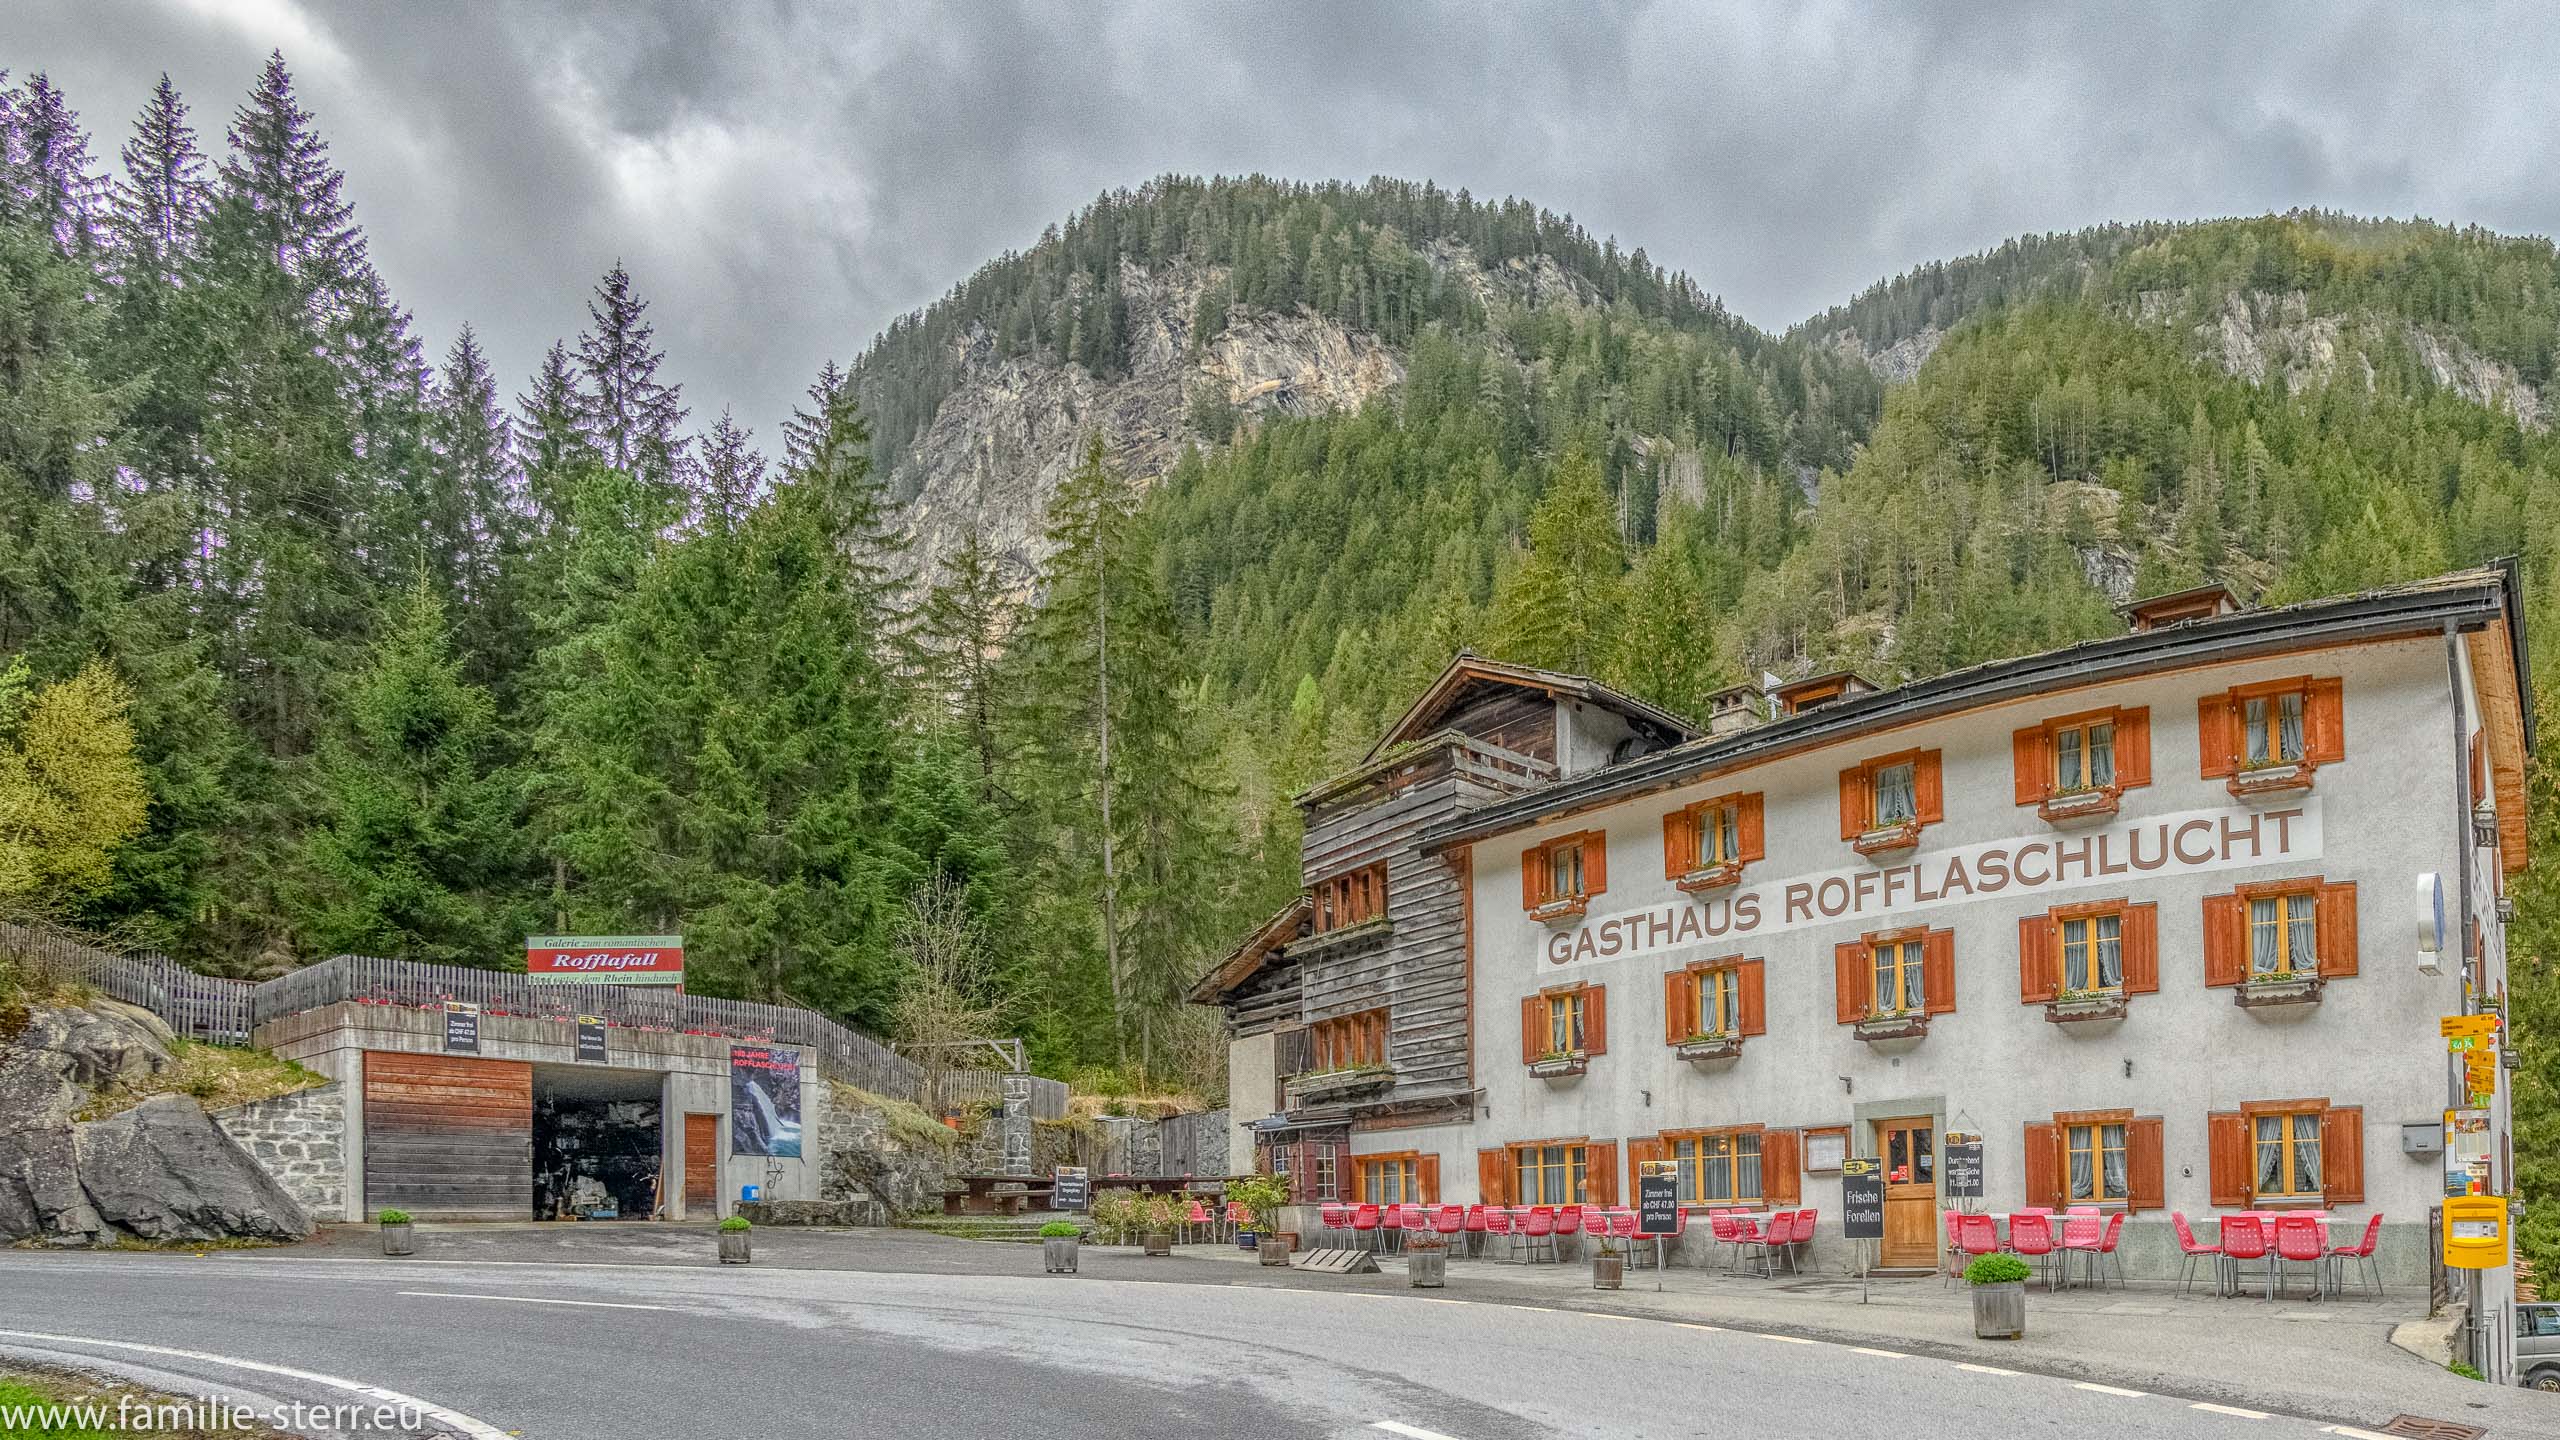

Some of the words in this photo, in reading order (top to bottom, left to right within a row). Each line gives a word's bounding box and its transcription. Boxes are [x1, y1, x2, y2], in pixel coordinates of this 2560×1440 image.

[1548, 892, 1761, 967] GASTHAUS
[1785, 807, 2305, 924] ROFFLASCHLUCHT
[545, 938, 579, 948] Galerie
[552, 953, 658, 970] Rofflafall
[604, 974, 633, 983] Rhein
[1644, 1189, 1663, 1198] Zimmer
[1664, 1188, 1673, 1198] frei
[1847, 1190, 1878, 1204] Frische
[1649, 1200, 1660, 1210] CHF
[1654, 1211, 1672, 1221] Person
[1846, 1209, 1880, 1223] Forellen
